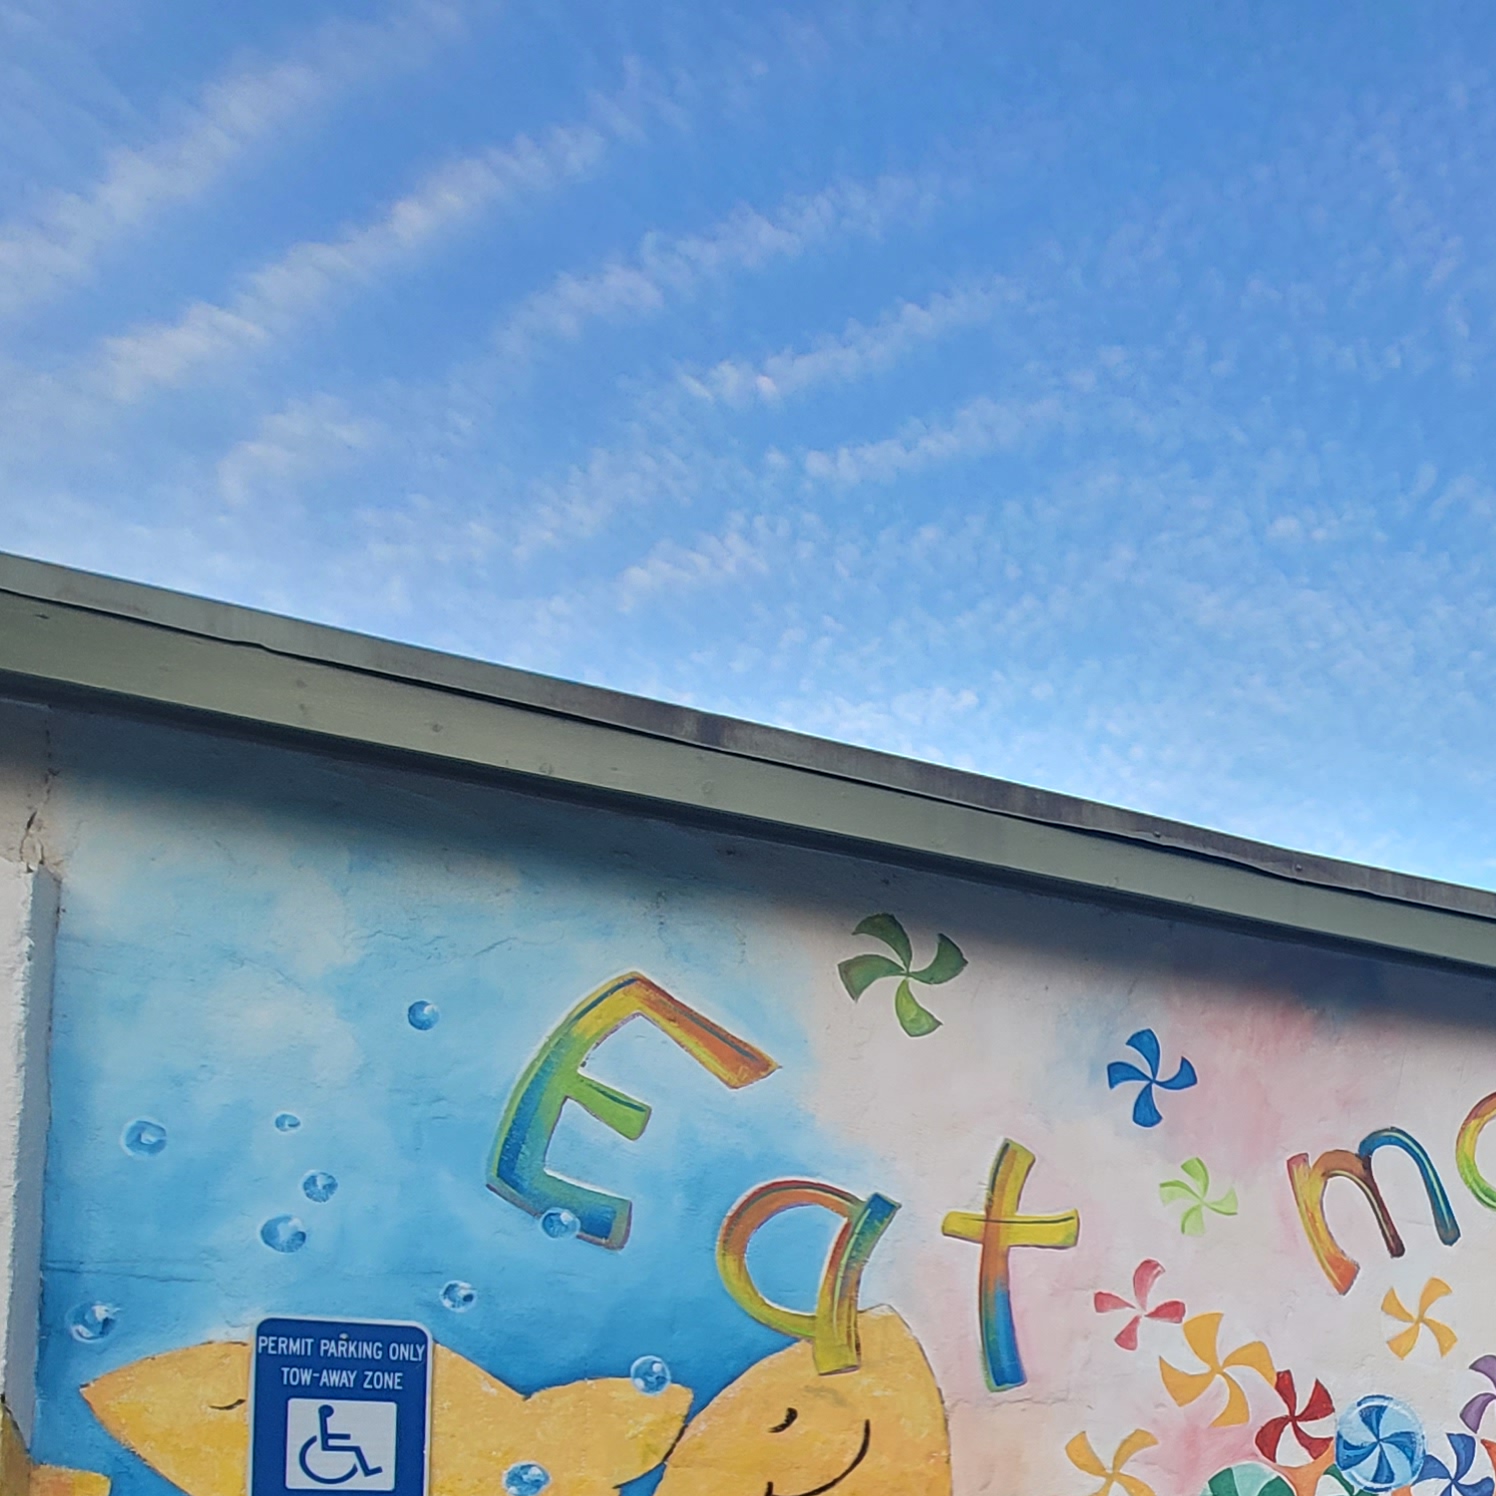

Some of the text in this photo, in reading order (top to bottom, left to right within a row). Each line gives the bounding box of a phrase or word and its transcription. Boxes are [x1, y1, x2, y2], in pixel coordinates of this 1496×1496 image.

[486, 971, 1079, 1391] Eat
[257, 1335, 425, 1362] PERMIT PARKING ONLY
[281, 1367, 403, 1390] TOW-AWAY ZONE
